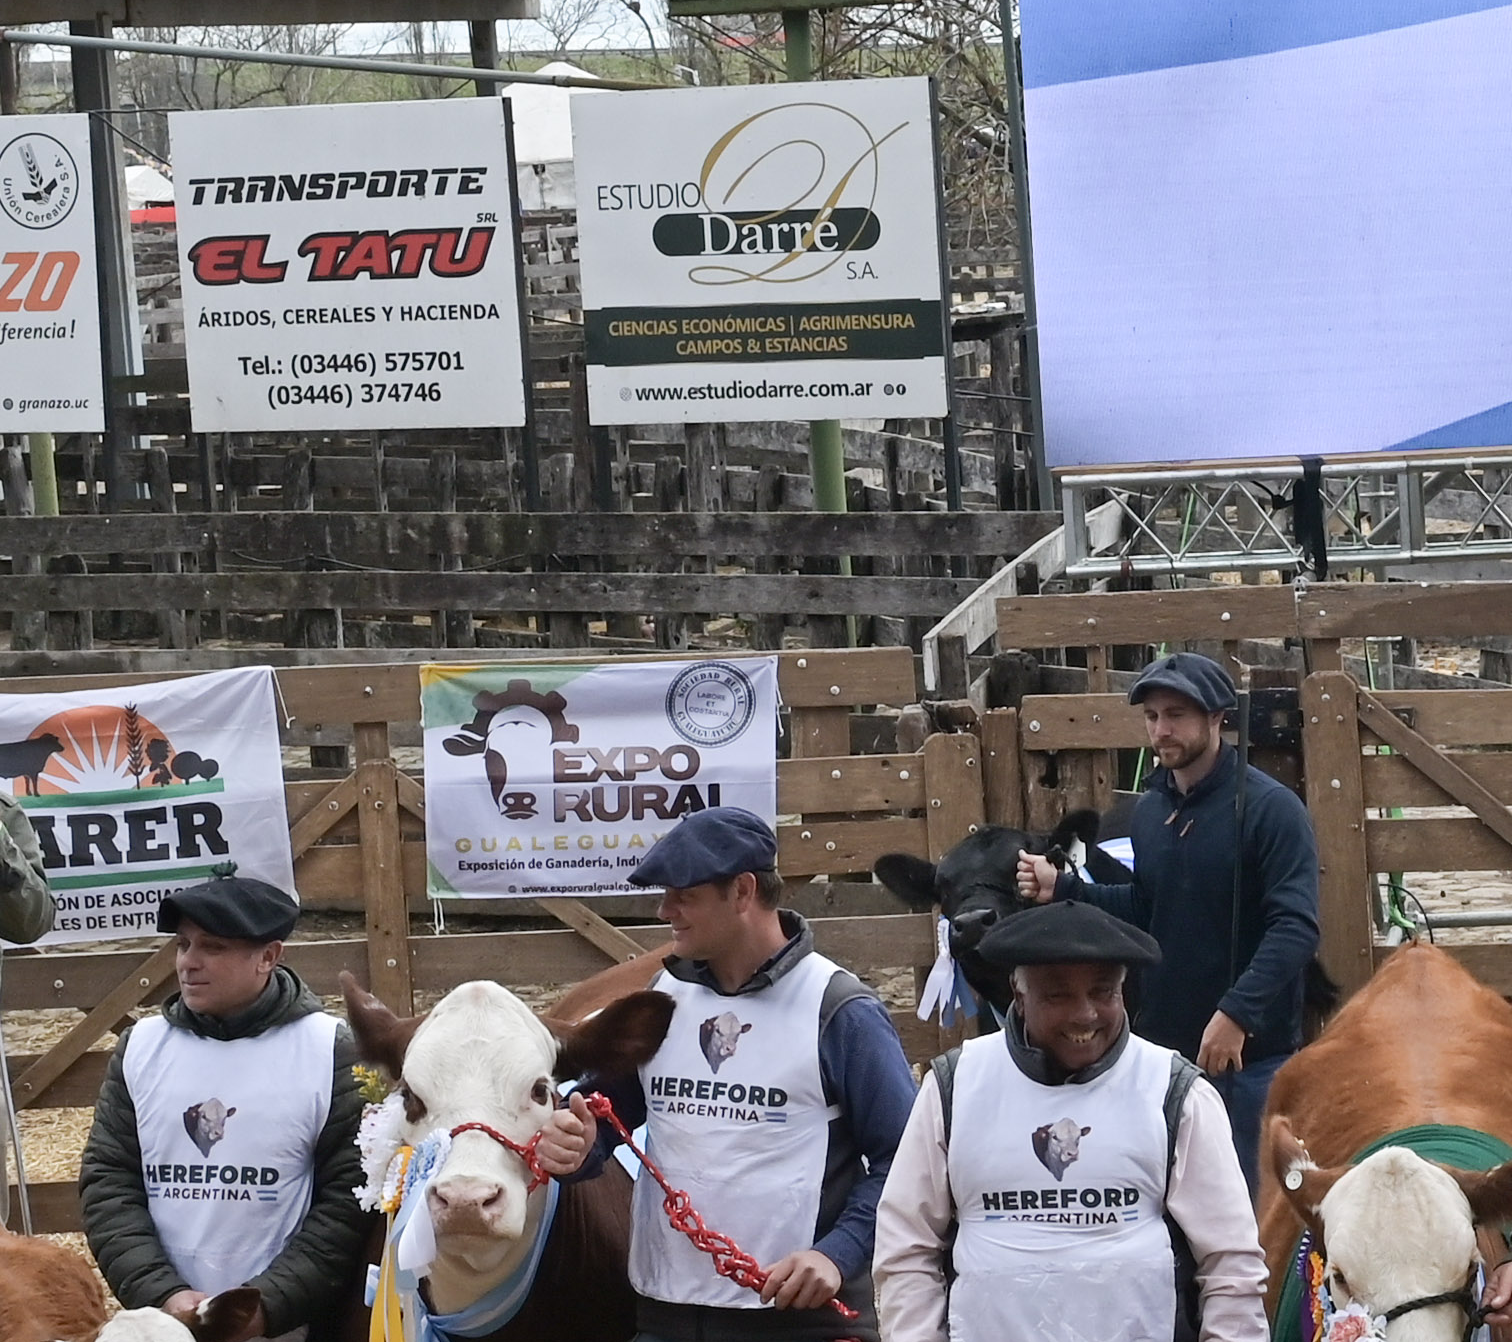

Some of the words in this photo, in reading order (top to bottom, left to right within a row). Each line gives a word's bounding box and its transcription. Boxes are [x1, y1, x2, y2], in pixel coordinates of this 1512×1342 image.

[3, 178, 22, 215] Unión
[25, 186, 70, 222] Cerealera
[54, 154, 69, 181] S.A.
[189, 167, 487, 205] TRANSPORTE
[597, 182, 701, 210] ESTUDIO
[476, 212, 499, 223] SRL
[698, 206, 839, 255] Darré
[188, 234, 289, 286] EL
[298, 226, 496, 282] TATU
[846, 262, 879, 280] S.A.
[198, 307, 275, 329] ÁRIDOS,
[283, 307, 375, 325] CEREALES
[382, 306, 392, 322] Y
[400, 304, 500, 321] HACIENDA
[608, 320, 678, 337] CIENCIAS
[682, 314, 786, 334] ECONÓMICAS
[799, 314, 915, 332] AGRIMENSURA
[676, 339, 742, 355] CAMPOS
[747, 338, 761, 353] &
[765, 336, 848, 352] ESTANCIAS
[238, 356, 283, 375] Tel.:
[291, 353, 375, 378] (03446)
[385, 351, 464, 372] 575701
[268, 384, 352, 409] (03446)
[361, 382, 441, 403] 374746
[635, 381, 874, 401] www.estudiodarre.com.ar
[19, 399, 89, 413] granazo.uc
[552, 744, 701, 784] EXPO
[34, 801, 229, 869] ARER
[458, 860, 525, 873] Exposición
[528, 858, 543, 870] de
[545, 856, 614, 870] Ganadería,
[84, 894, 106, 909] DE
[86, 915, 107, 929] DE
[650, 1077, 788, 1108] HEREFORD
[667, 1102, 760, 1122] ARGENTINA
[146, 1164, 280, 1186] HEREFORD
[163, 1188, 252, 1201] ARGENTINA
[982, 1187, 1140, 1210] HEREFORD
